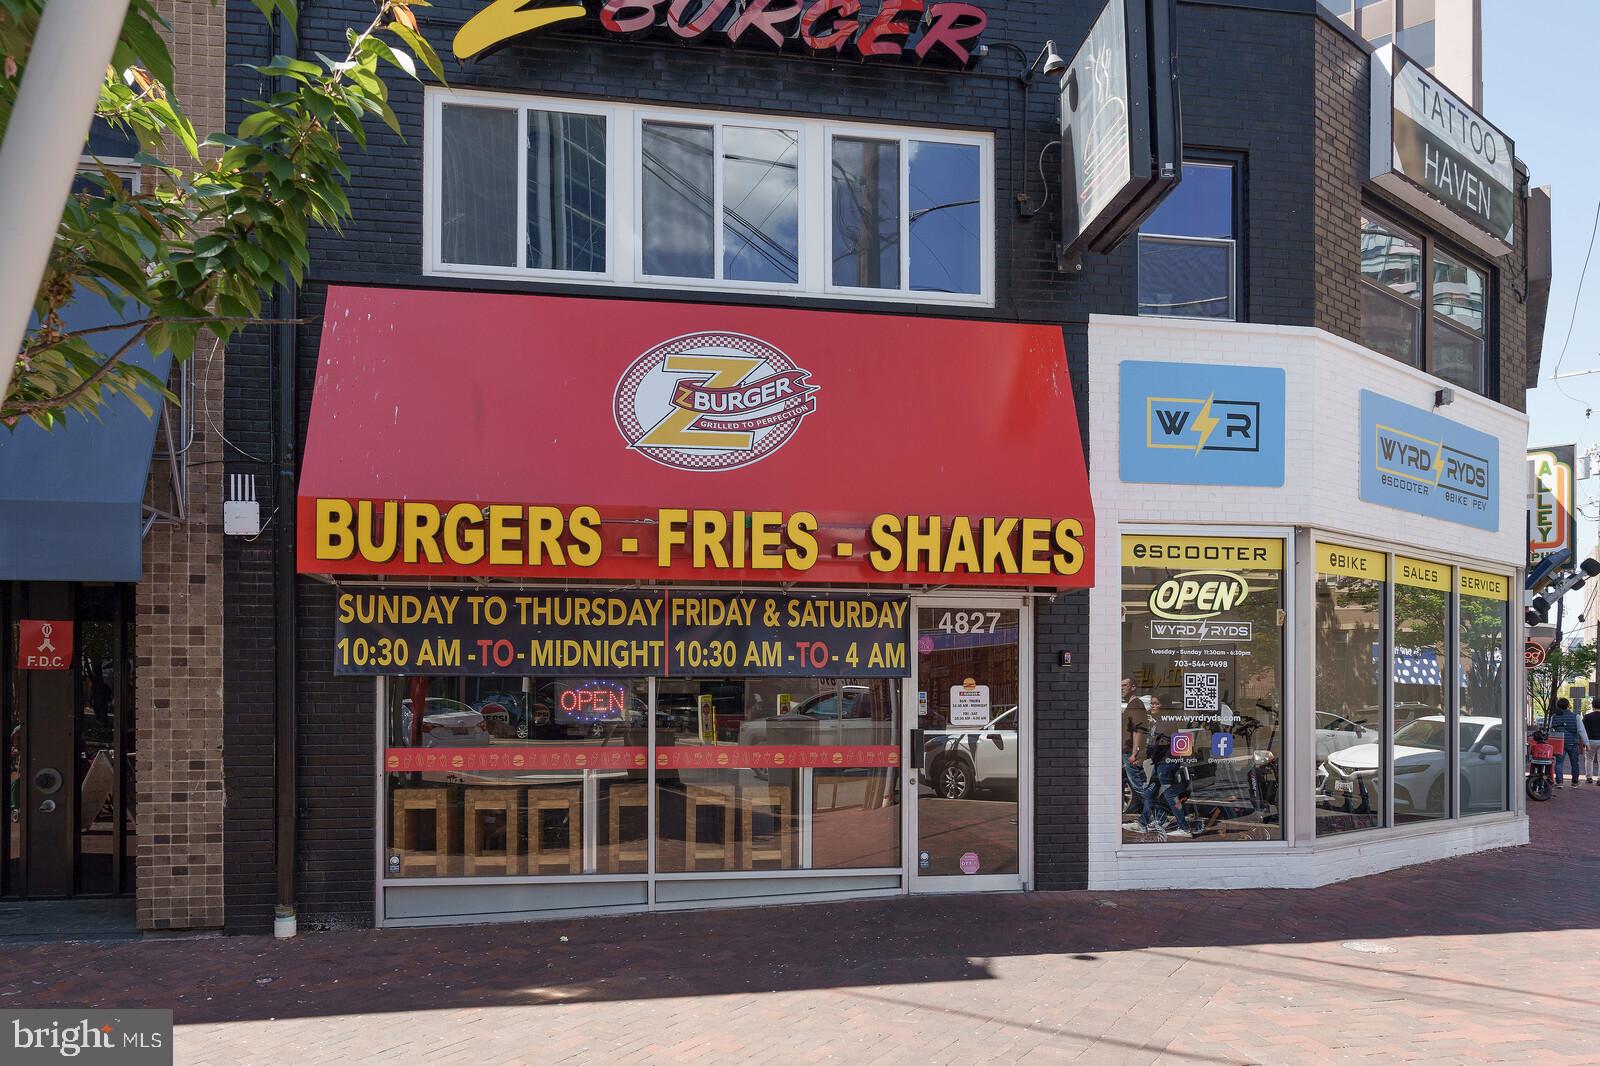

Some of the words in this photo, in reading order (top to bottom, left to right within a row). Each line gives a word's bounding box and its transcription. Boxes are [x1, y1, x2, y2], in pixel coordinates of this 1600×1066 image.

[600, 0, 988, 64] BURGER
[1417, 77, 1496, 165] TATTOO
[1424, 143, 1491, 220] HAVEN
[694, 378, 793, 411] BURGER
[700, 421, 740, 429] GRILLED
[757, 405, 809, 426] PERFECTION
[1380, 436, 1431, 471] WYRD
[1447, 457, 1486, 488] RYDS
[1381, 474, 1429, 496] eSCOOTER
[1445, 491, 1468, 506] eBIKE
[1472, 498, 1487, 511] PEV
[1537, 461, 1553, 542] ALLEY
[316, 498, 602, 567] BURGERS
[658, 508, 818, 570] FRIES
[870, 513, 1085, 575] SHAKES
[1133, 543, 1267, 561] eSCOOTER
[1329, 552, 1367, 571] eBIKE
[1403, 565, 1438, 582] SALES
[1461, 576, 1501, 593] SERVICE
[1156, 580, 1239, 611] OPEN
[338, 594, 460, 624] SUNDAY
[467, 596, 507, 625] TO
[515, 597, 663, 626] THURSDAY
[672, 598, 757, 626] FRIDAY
[763, 600, 781, 627] &
[788, 600, 908, 628] SATURDAY
[938, 612, 1001, 634] 4827
[1154, 625, 1196, 635] WYRD
[1210, 626, 1249, 636] RYDS
[27, 655, 64, 667] F.D.C.
[337, 638, 409, 666] 10:30
[416, 639, 461, 666] AM
[531, 639, 664, 667] MIDNIGHT
[675, 640, 737, 667] 10:30
[743, 641, 782, 667] AM
[845, 642, 859, 668] 4
[867, 642, 905, 668] AM
[1150, 648, 1176, 656] Tuesday
[1180, 648, 1202, 656] Sunday
[1174, 660, 1228, 668] 703-544-9498
[561, 690, 625, 711] OPEN
[1161, 713, 1241, 723] www.wyrdryds.com
